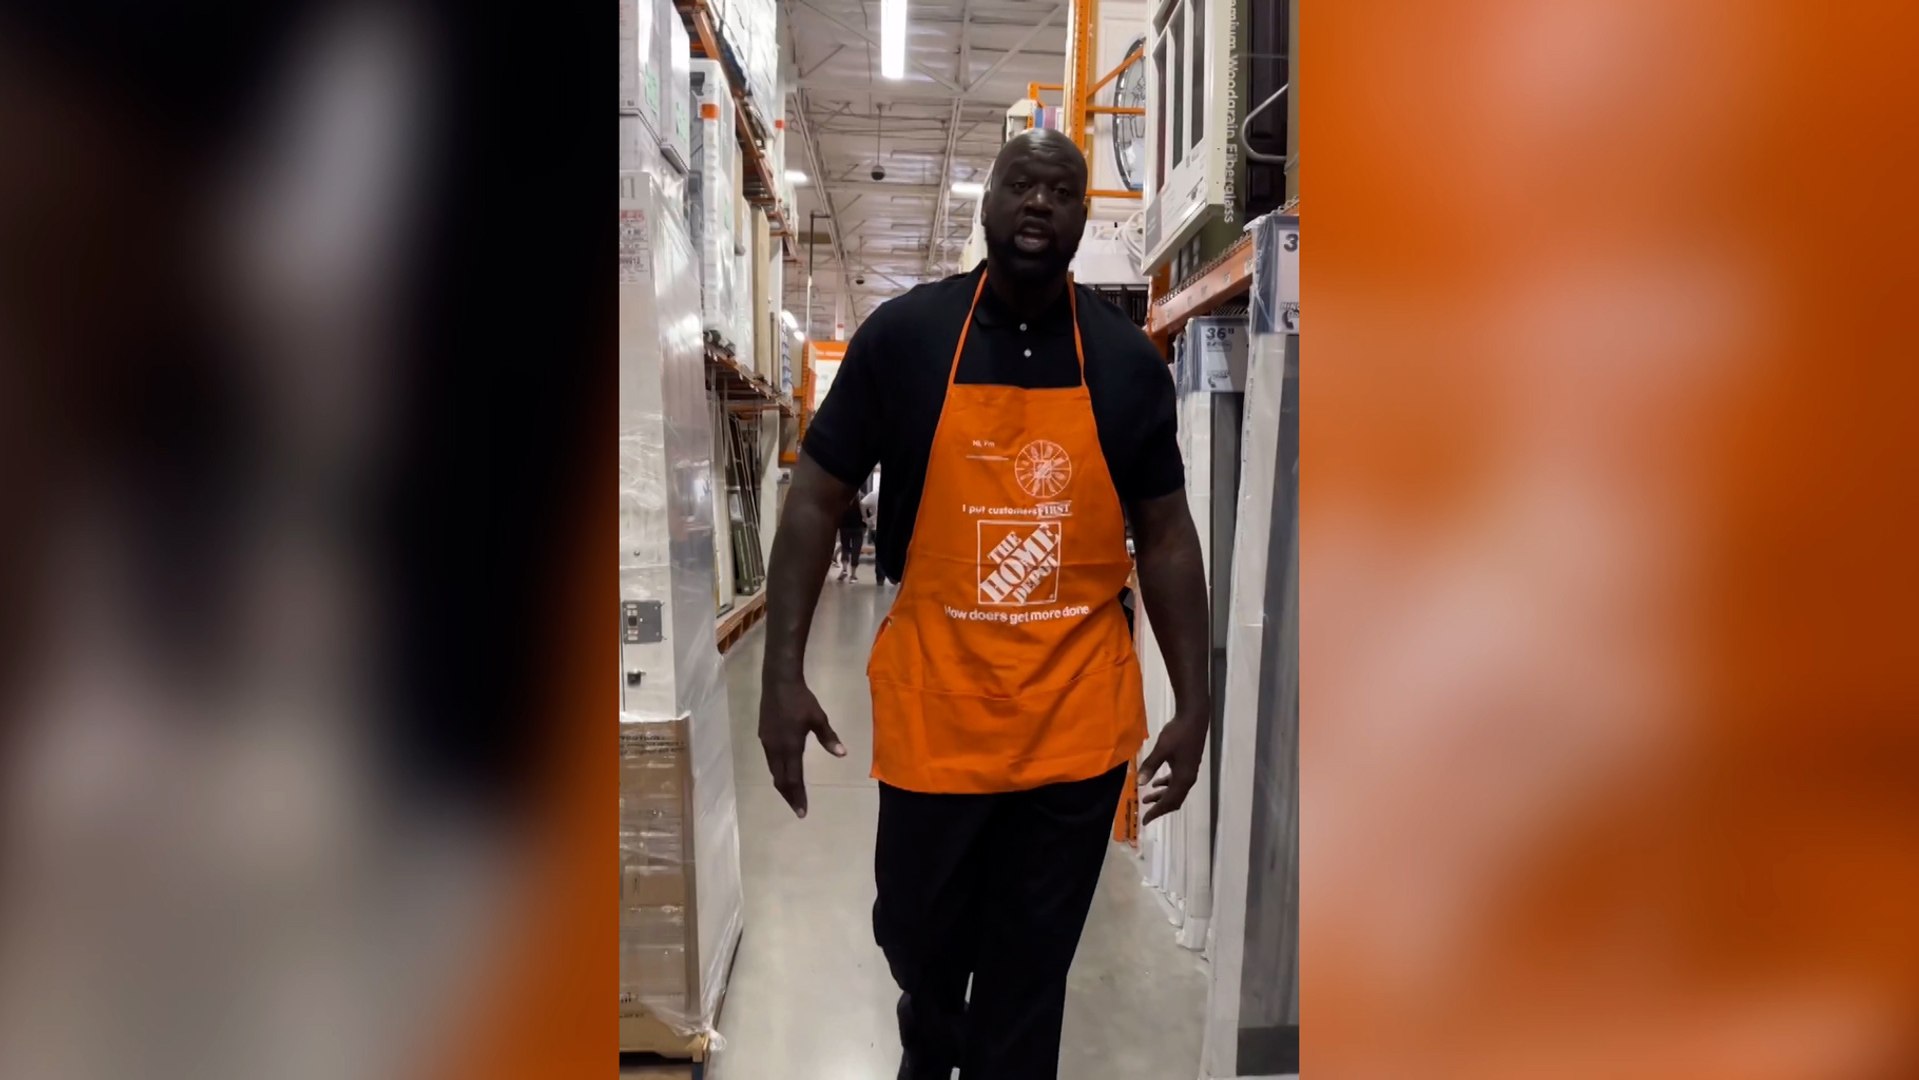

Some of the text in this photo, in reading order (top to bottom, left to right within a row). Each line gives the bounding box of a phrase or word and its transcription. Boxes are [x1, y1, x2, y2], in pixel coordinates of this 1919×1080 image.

[1224, 144, 1239, 223] Fiberglass
[962, 504, 1070, 516] I put customers FIRST
[980, 523, 1059, 604] HOME
[987, 531, 1022, 564] THE
[1012, 552, 1058, 604] DEPOT
[969, 608, 1008, 622] doers
[1009, 610, 1030, 625] get
[1030, 609, 1061, 621] more
